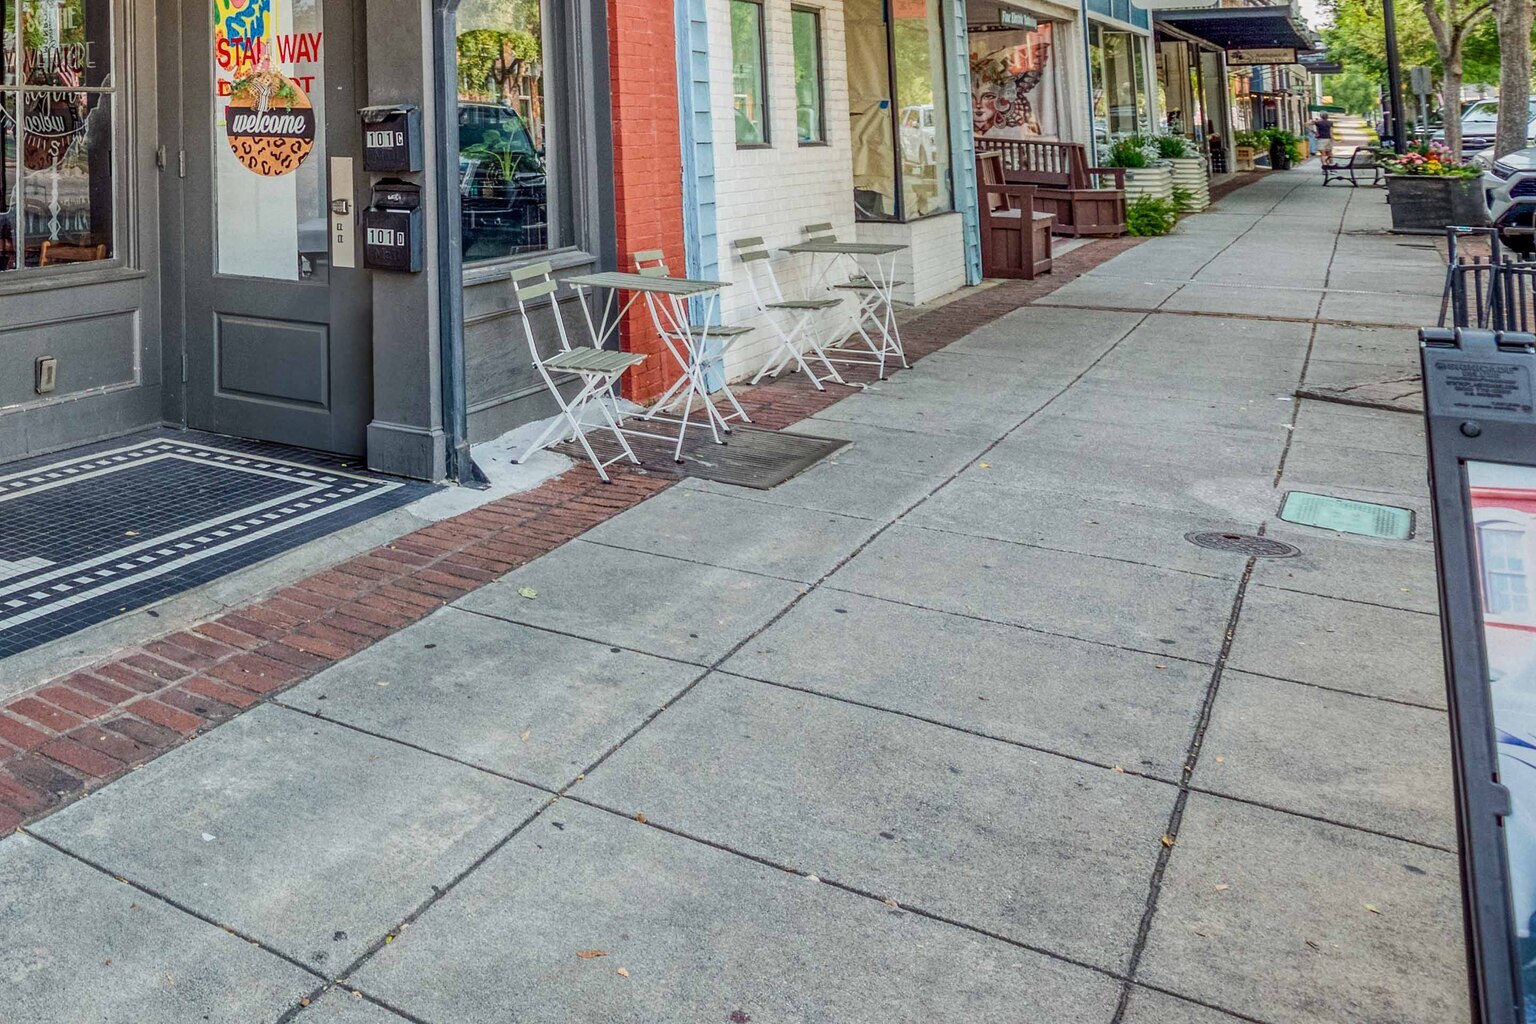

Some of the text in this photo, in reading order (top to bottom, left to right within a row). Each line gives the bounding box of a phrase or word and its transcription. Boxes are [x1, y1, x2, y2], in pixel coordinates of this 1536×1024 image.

[217, 32, 322, 67] STAIWAY
[232, 112, 306, 134] welcome
[369, 132, 392, 146] 101
[370, 230, 392, 244] 101
